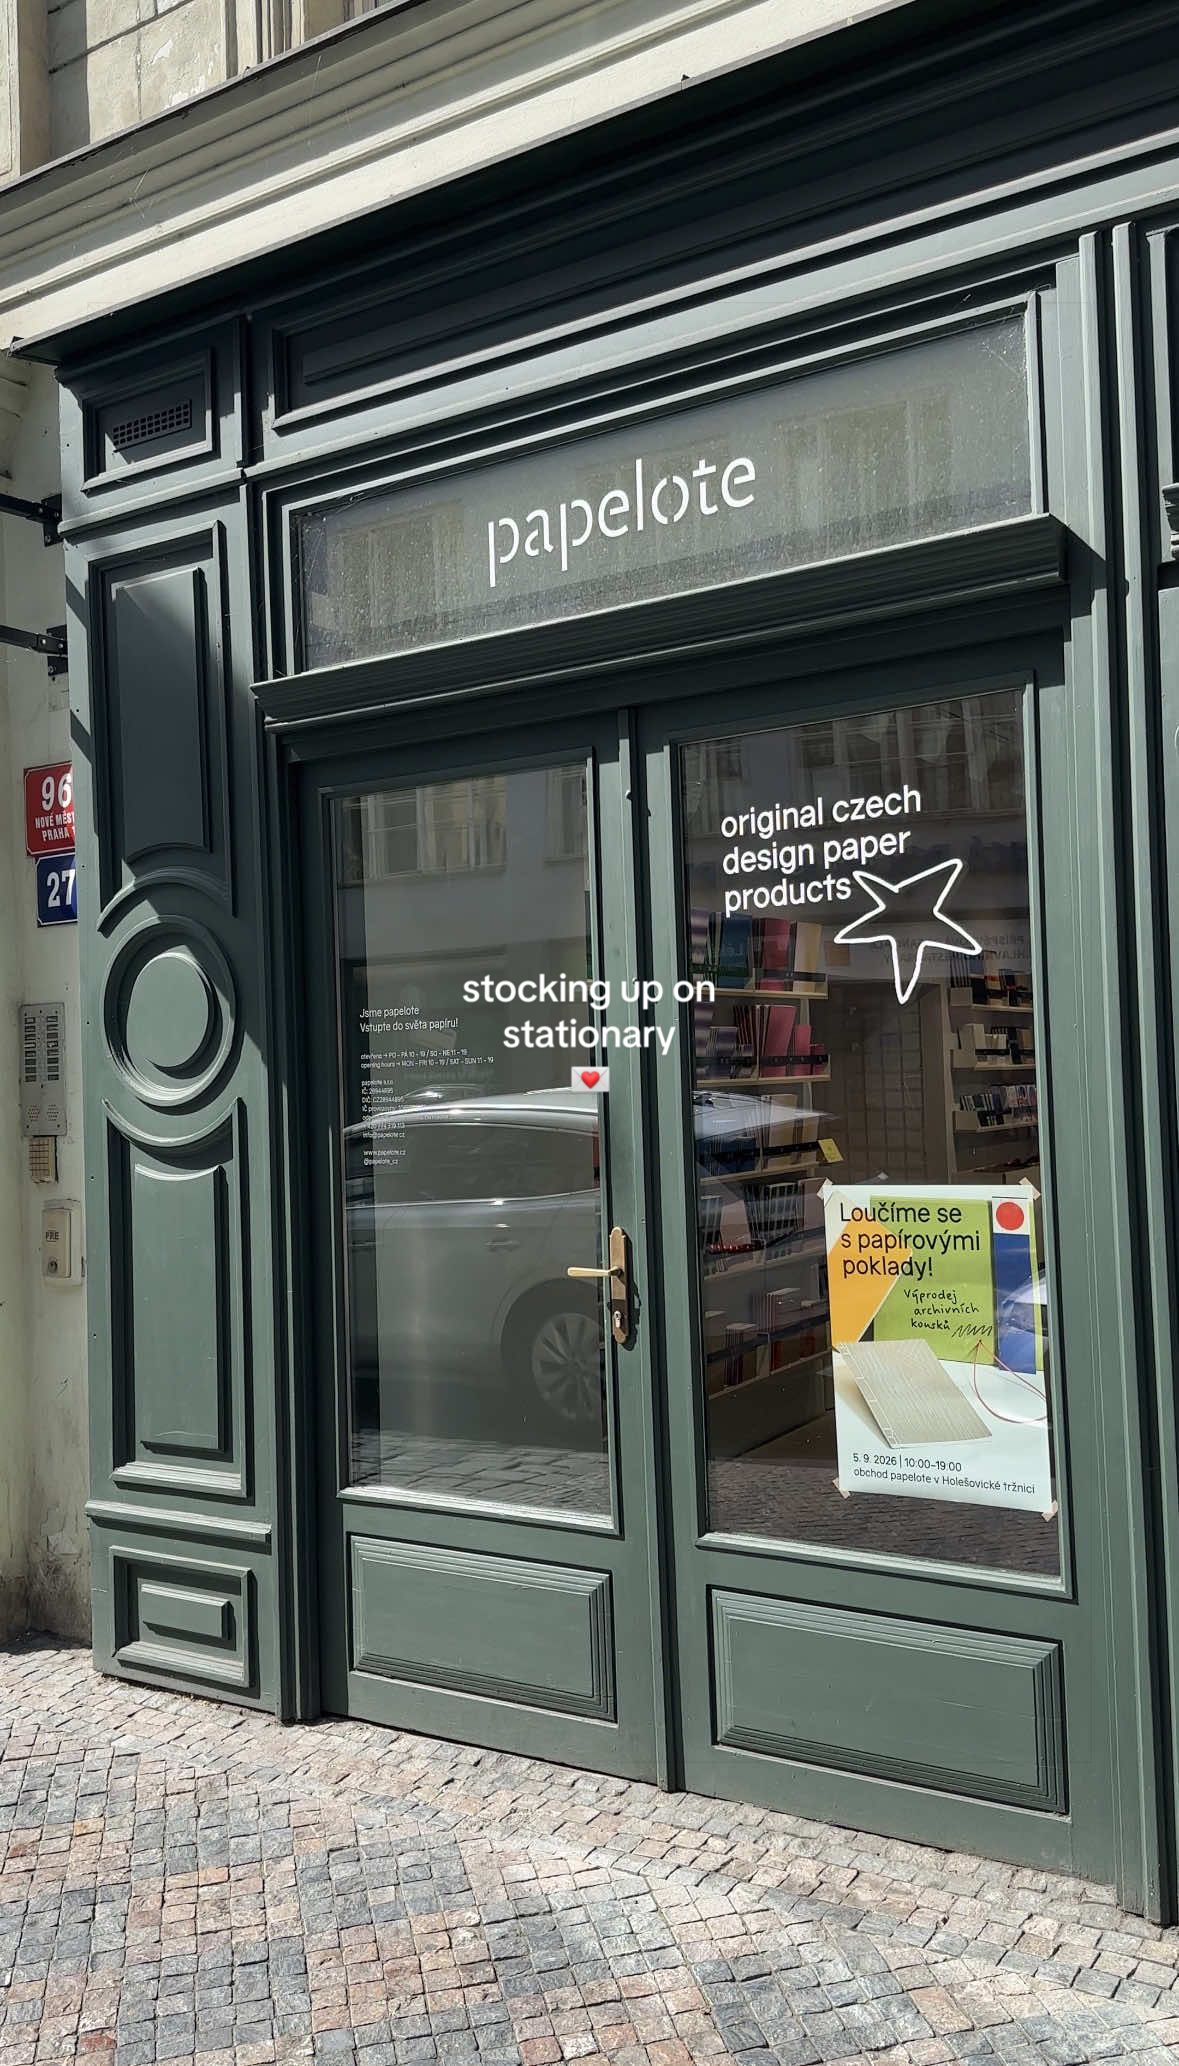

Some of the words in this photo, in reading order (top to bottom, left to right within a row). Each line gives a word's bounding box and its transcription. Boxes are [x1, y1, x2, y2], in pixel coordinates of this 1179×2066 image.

[488, 457, 756, 588] papelote
[35, 812, 54, 829] NOVÉ
[55, 810, 75, 826] MĚST
[721, 797, 823, 839] original
[832, 785, 921, 822] czech
[42, 828, 69, 842] PRAHA
[723, 842, 814, 875] design
[823, 831, 911, 868] paper
[47, 869, 76, 908] 27
[725, 874, 851, 918] products
[360, 1008, 382, 1018] Jsme
[383, 1006, 420, 1018] papelote
[360, 1022, 391, 1034] Vstupte
[392, 1021, 403, 1031] do
[405, 1020, 427, 1030] světa
[429, 1017, 458, 1030] papíru!
[840, 1202, 930, 1223] Loučíme
[937, 1209, 961, 1223] se
[841, 1234, 851, 1249] s
[858, 1229, 981, 1255] papírovými
[843, 1256, 933, 1281] poklady!
[904, 1289, 957, 1304] Výprodej
[914, 1303, 980, 1315] archivních
[911, 1318, 950, 1331] kousků
[874, 1455, 897, 1466] 2026
[854, 1467, 888, 1479] obchod
[890, 1471, 932, 1485] papelote
[933, 1477, 939, 1485] v
[942, 1475, 1001, 1491] Holešovické
[1002, 1482, 1036, 1495] tržnici
